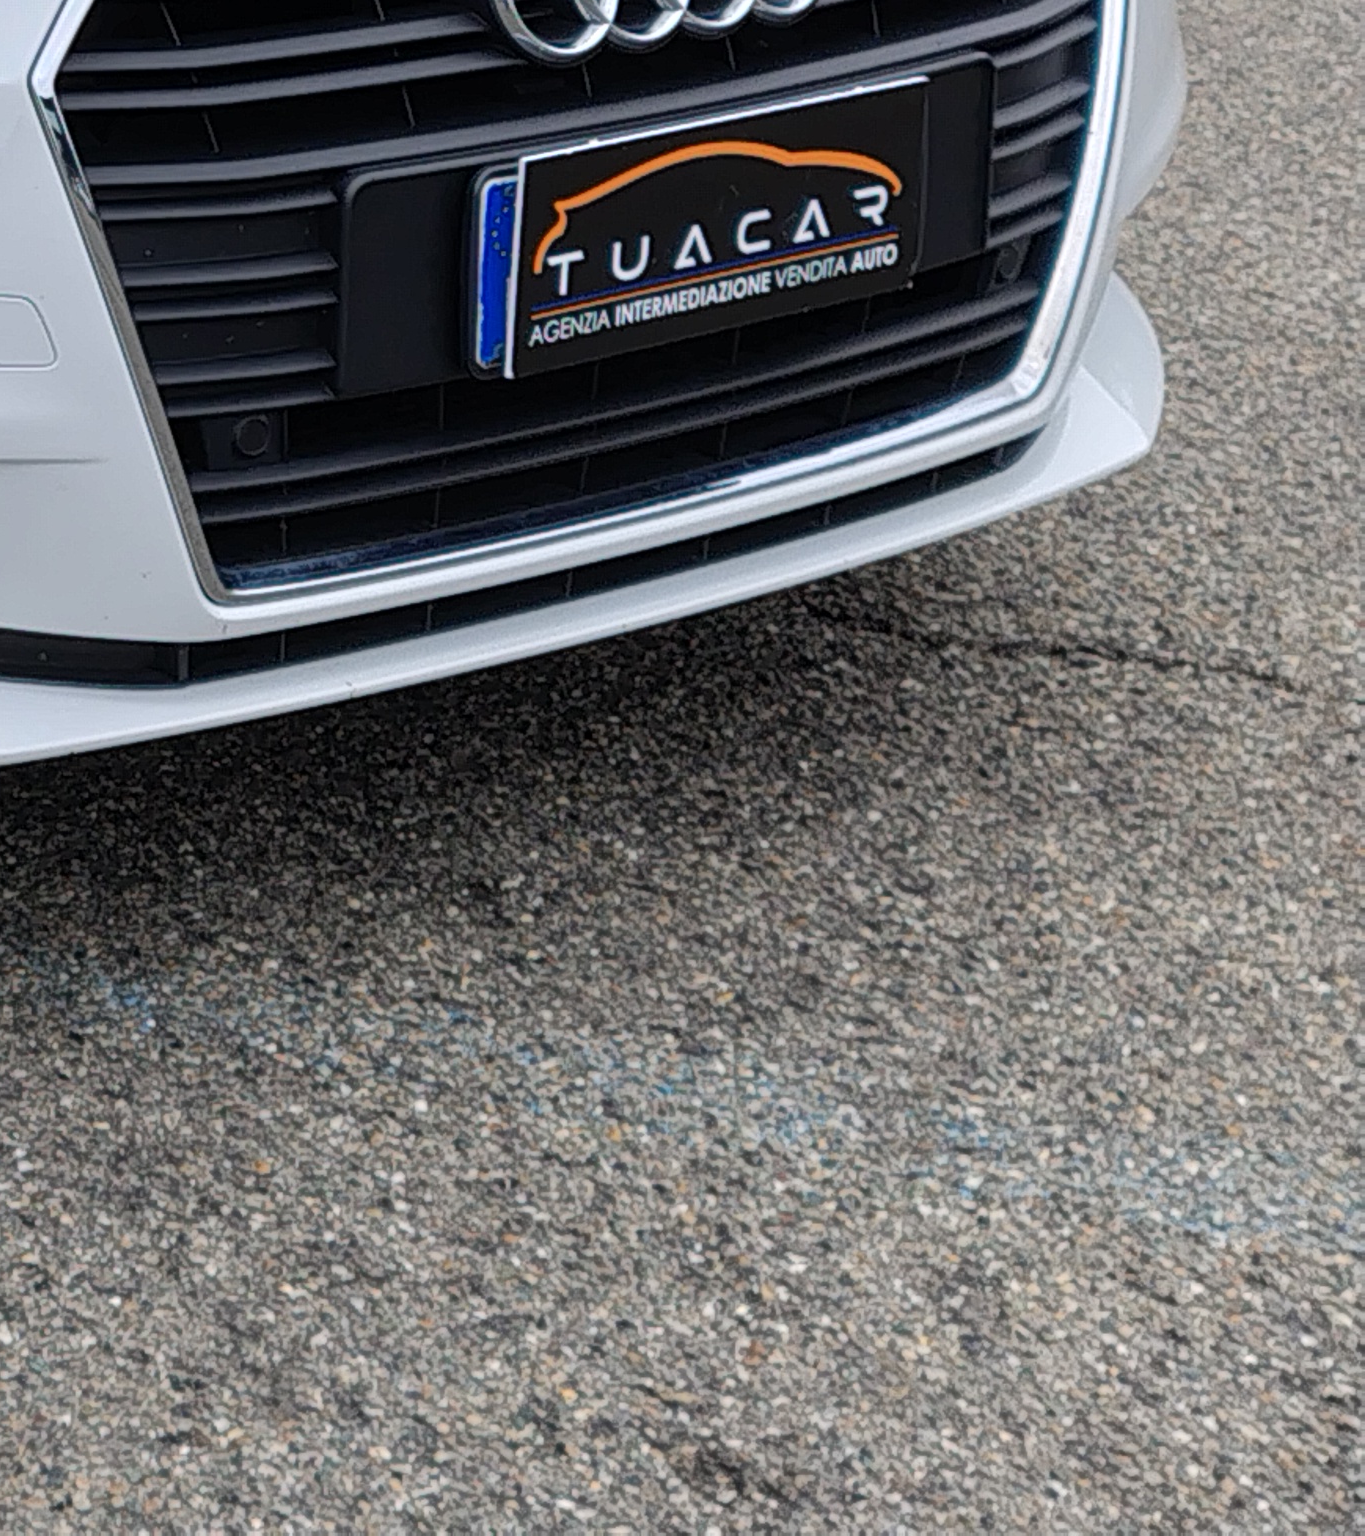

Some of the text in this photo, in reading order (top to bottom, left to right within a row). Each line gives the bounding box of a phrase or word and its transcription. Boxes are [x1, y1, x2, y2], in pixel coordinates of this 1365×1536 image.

[547, 184, 888, 296] TUACAR
[528, 243, 898, 347] AGENZIA INTERMEDIAZIONE VENDITA AUTO
